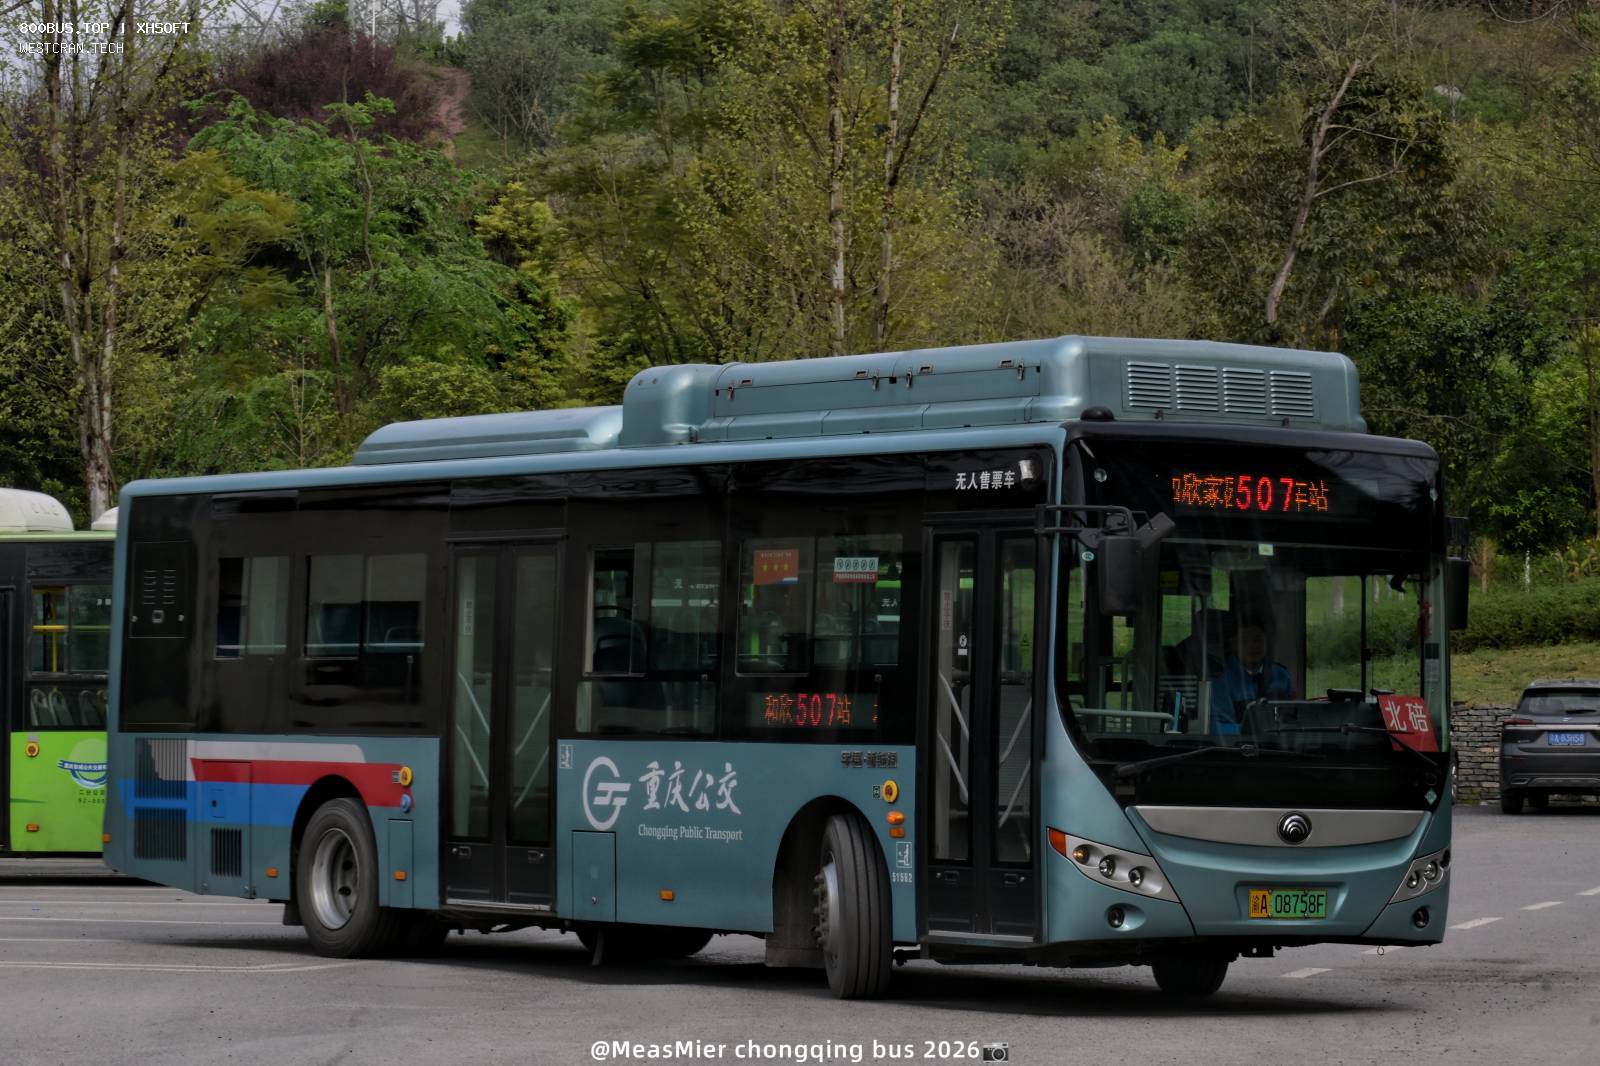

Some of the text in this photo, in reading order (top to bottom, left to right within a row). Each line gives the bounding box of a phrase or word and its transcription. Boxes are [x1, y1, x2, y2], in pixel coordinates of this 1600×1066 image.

[955, 470, 1015, 490] 无人售票车
[1236, 475, 1294, 512] 507
[796, 693, 837, 726] 507
[1384, 700, 1429, 732] 北碚
[638, 760, 742, 815] 重庆公交
[638, 824, 743, 843] Chongqing Public Transport
